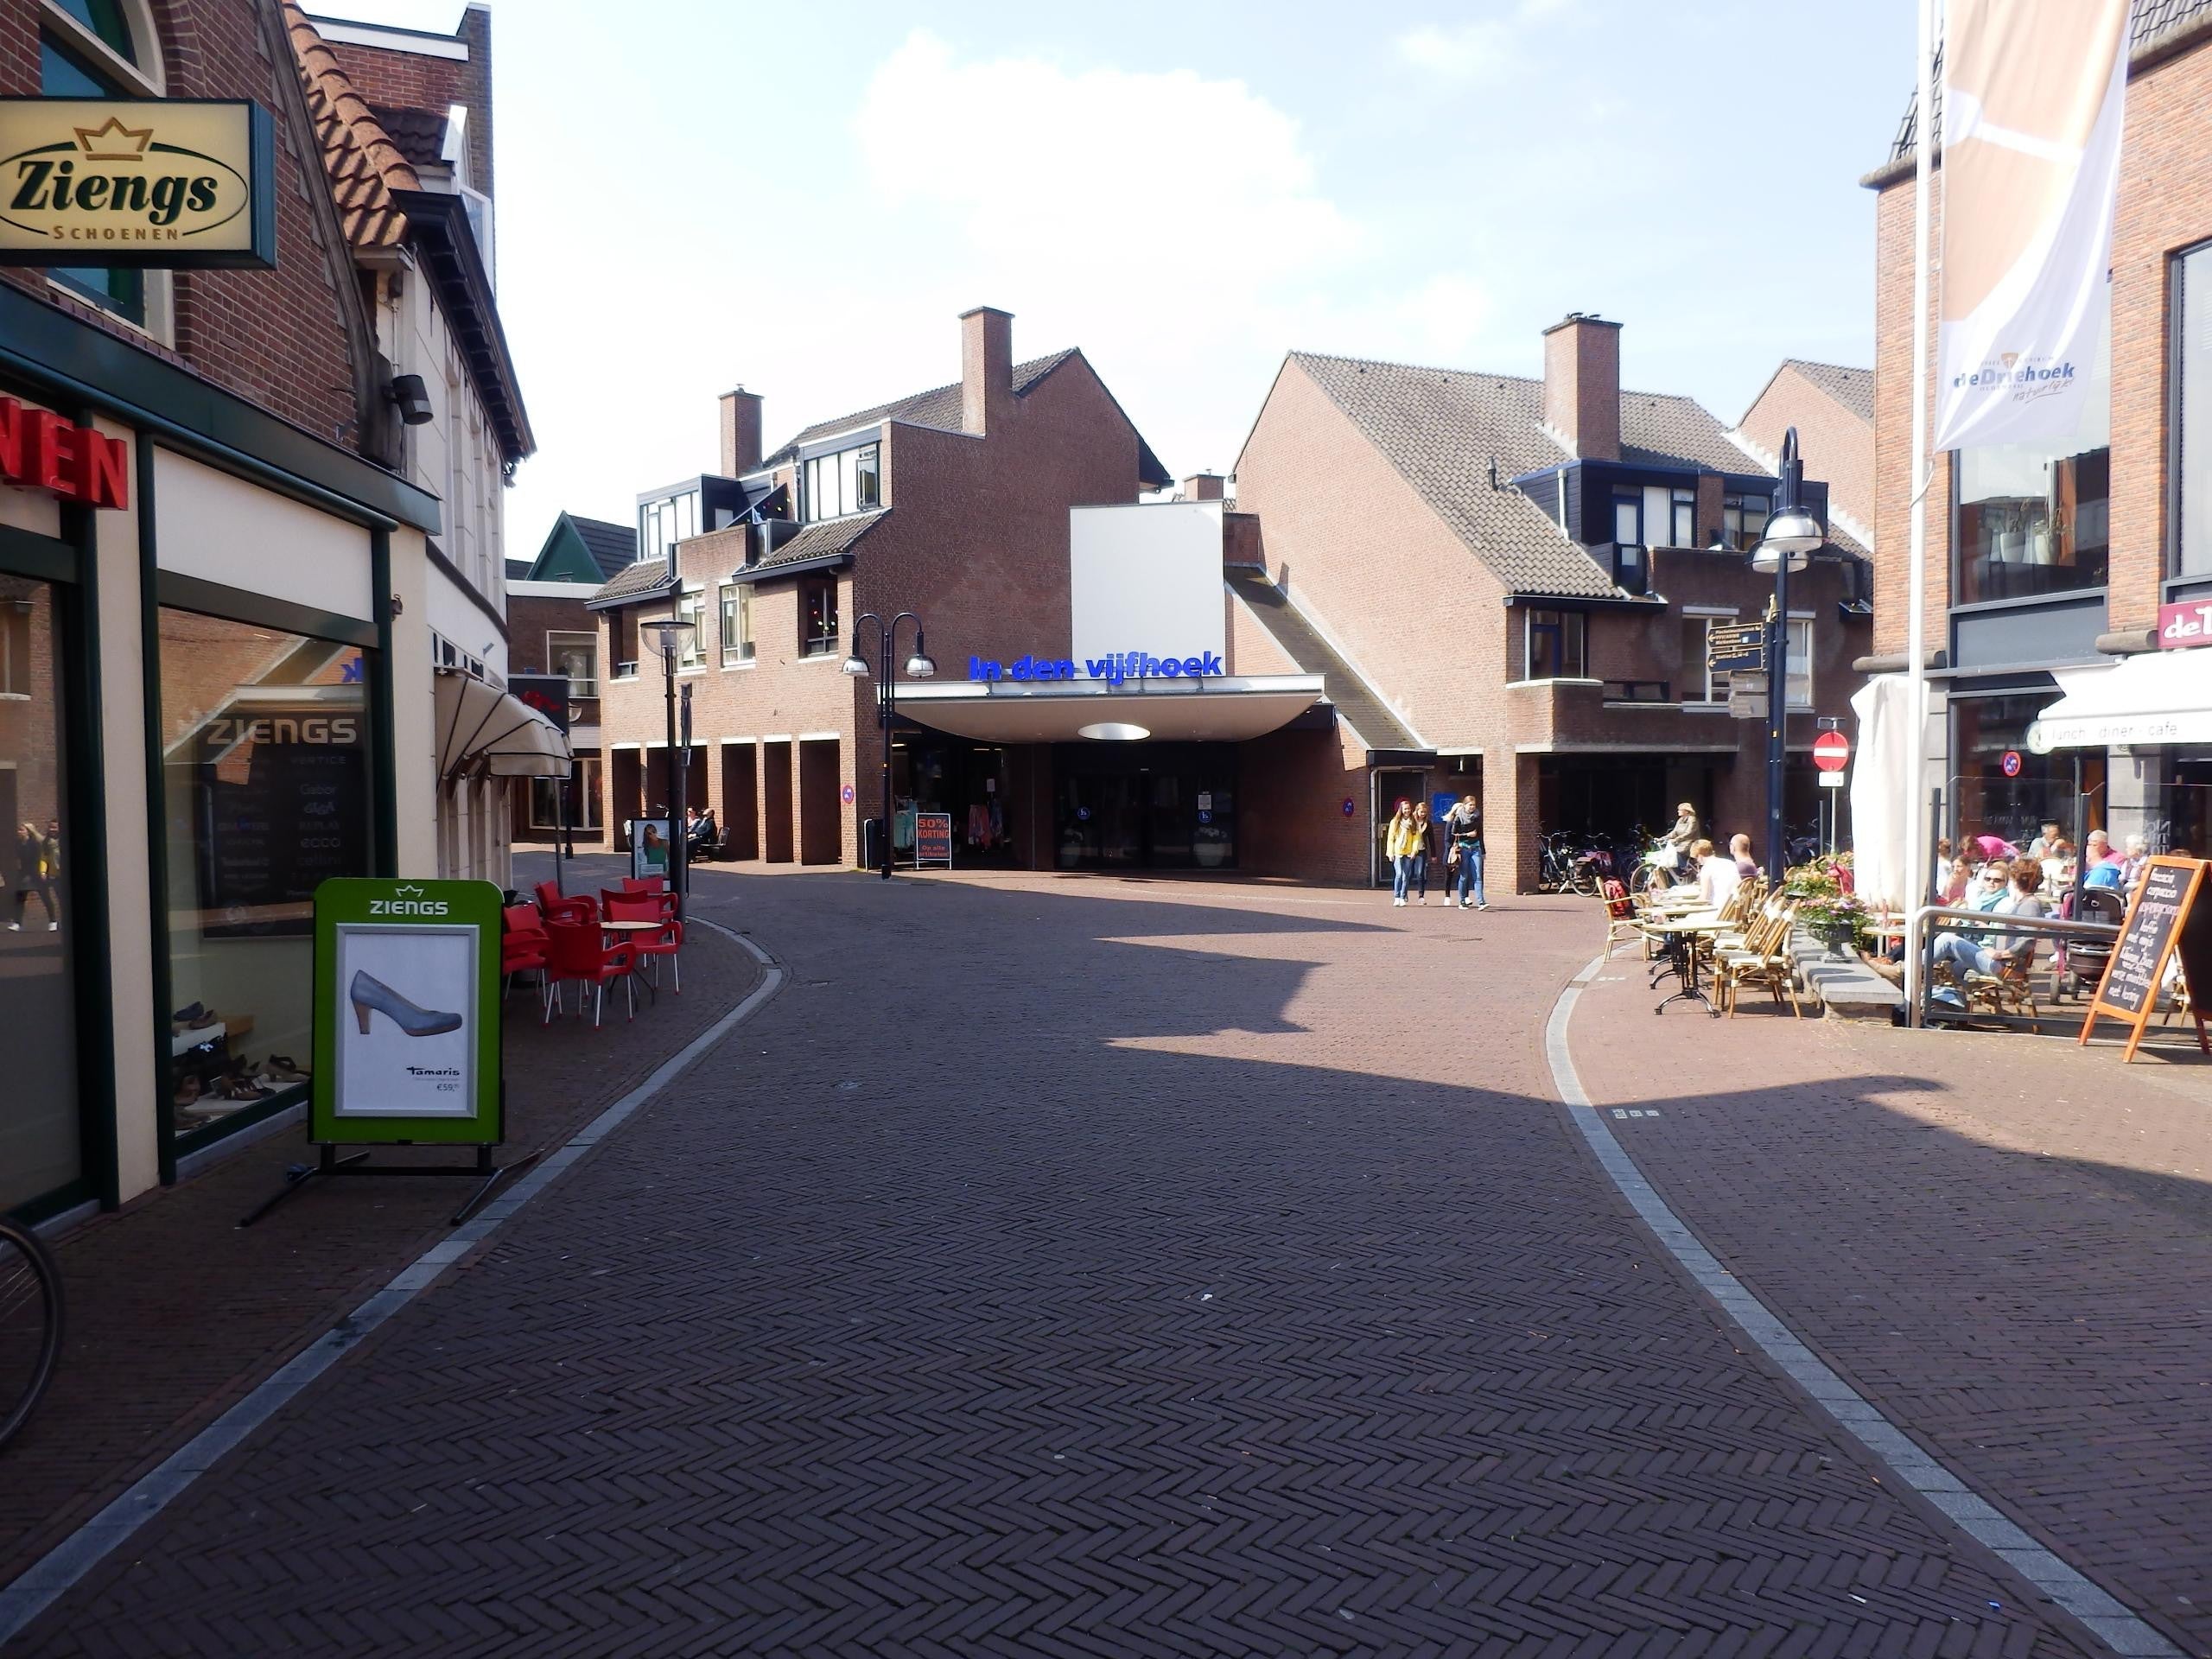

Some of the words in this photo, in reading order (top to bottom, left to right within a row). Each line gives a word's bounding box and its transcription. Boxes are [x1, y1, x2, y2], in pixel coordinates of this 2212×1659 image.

[10, 160, 218, 226] Ziengs
[54, 226, 178, 240] SCHOENEN
[969, 656, 1001, 680] In
[1011, 655, 1074, 680] den
[1085, 651, 1222, 685] vijfhoek
[207, 719, 357, 744] ZIENGS
[918, 818, 948, 828] 50%
[918, 830, 949, 838] KORTING
[370, 900, 448, 915] ZIENGS
[406, 1066, 460, 1076] Tamaris
